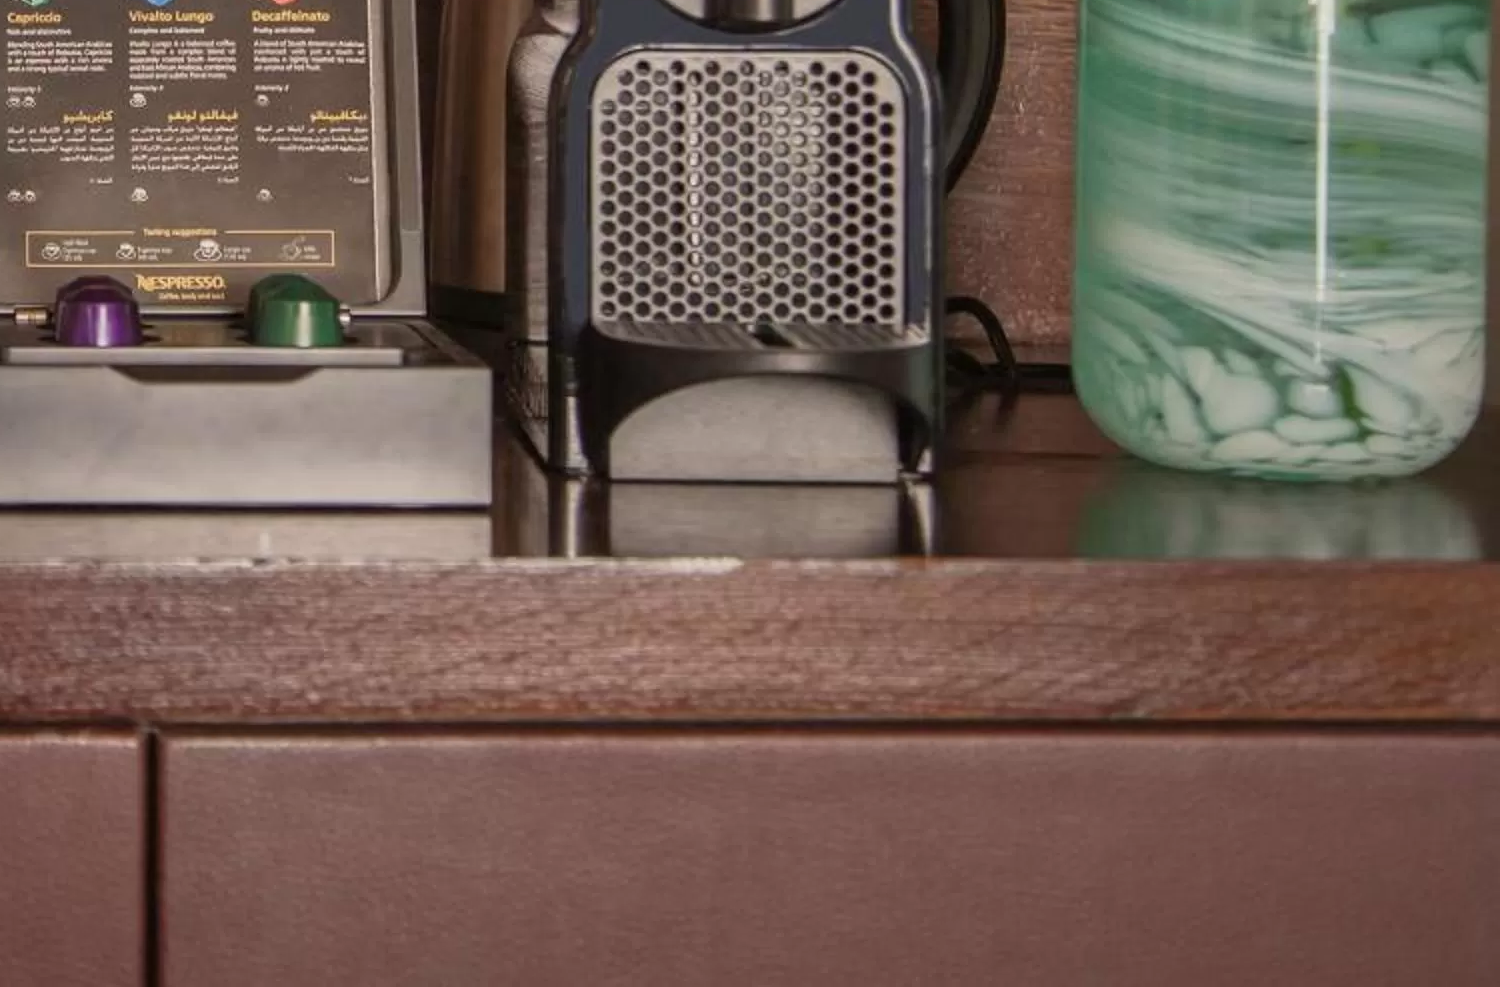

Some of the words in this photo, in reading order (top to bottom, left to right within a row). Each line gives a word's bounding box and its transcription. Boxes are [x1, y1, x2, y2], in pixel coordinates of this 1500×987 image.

[128, 10, 173, 22] Vivalto
[175, 10, 215, 24] Lungo
[251, 9, 331, 22] Decaffeinato
